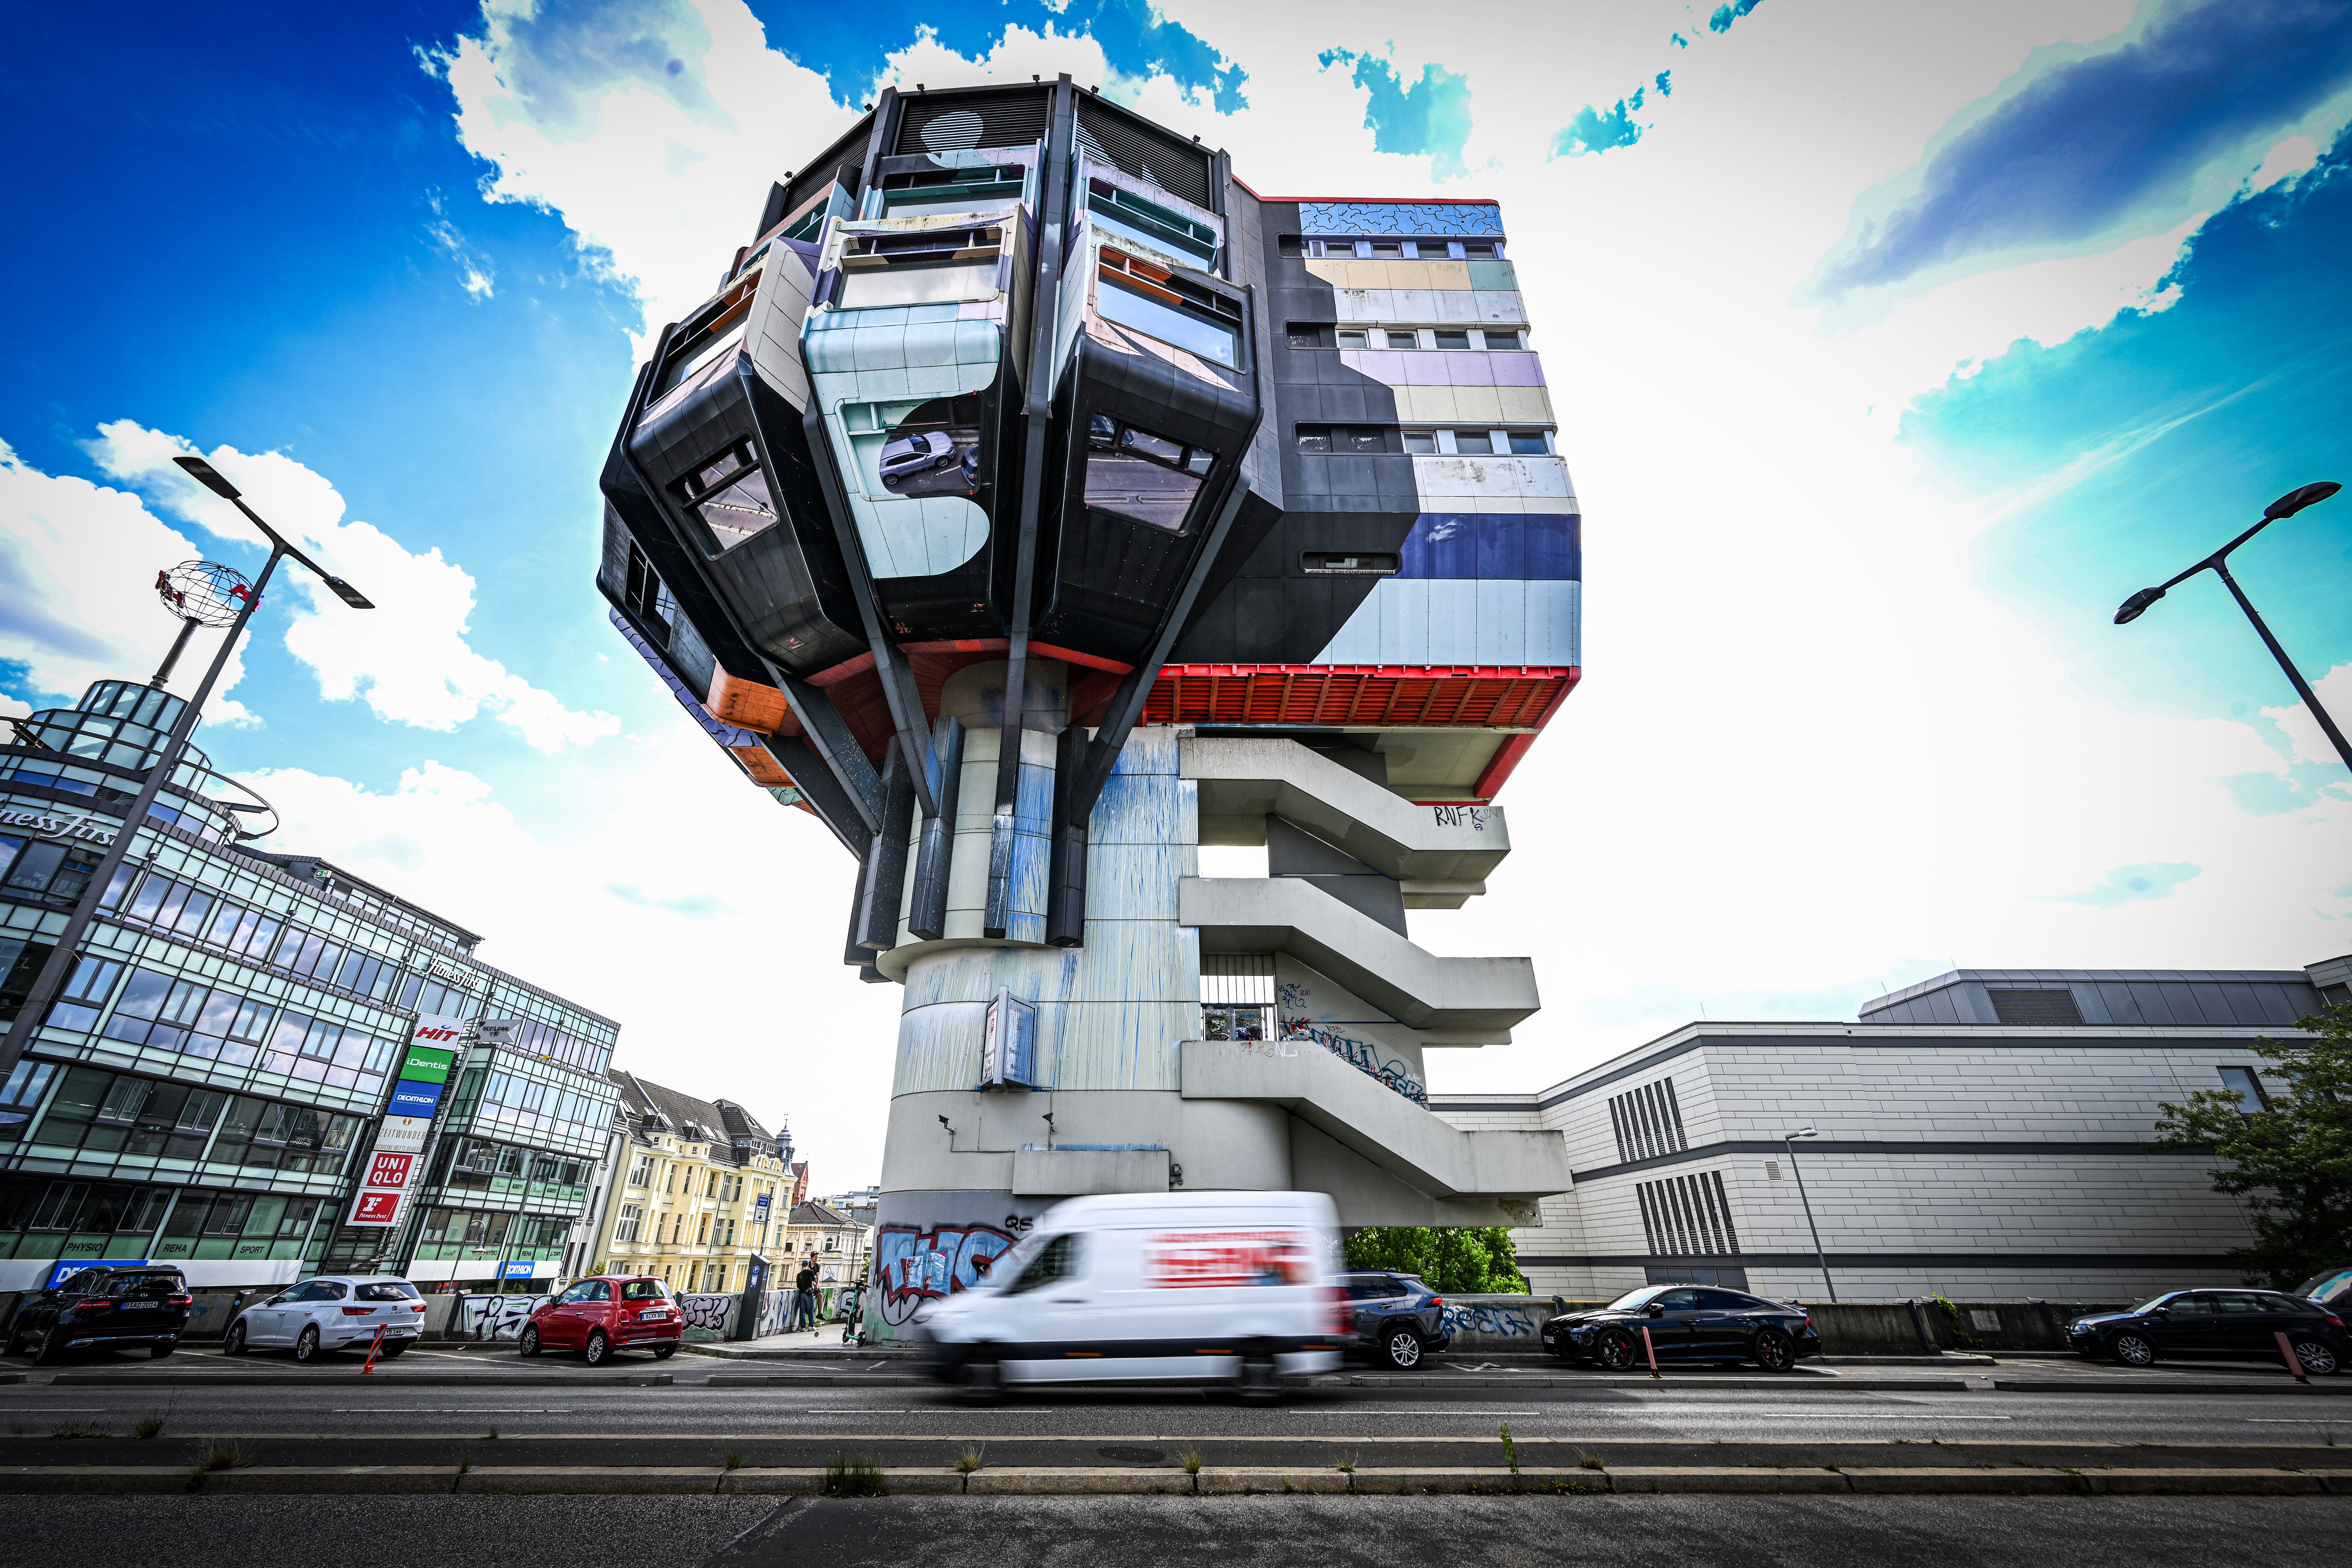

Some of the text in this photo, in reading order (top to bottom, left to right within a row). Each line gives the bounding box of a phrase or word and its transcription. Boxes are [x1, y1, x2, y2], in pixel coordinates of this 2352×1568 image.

[415, 1027, 460, 1042] HIT
[407, 1058, 448, 1070] iDentis
[397, 1094, 434, 1103] DECATHLON
[379, 1128, 426, 1140] ZEITWUNDER
[377, 1157, 406, 1170] UNI
[372, 1171, 403, 1185] QLO
[65, 1243, 102, 1252] PHYSIO
[163, 1244, 187, 1252] REHA
[506, 1265, 532, 1274] ECATHLON
